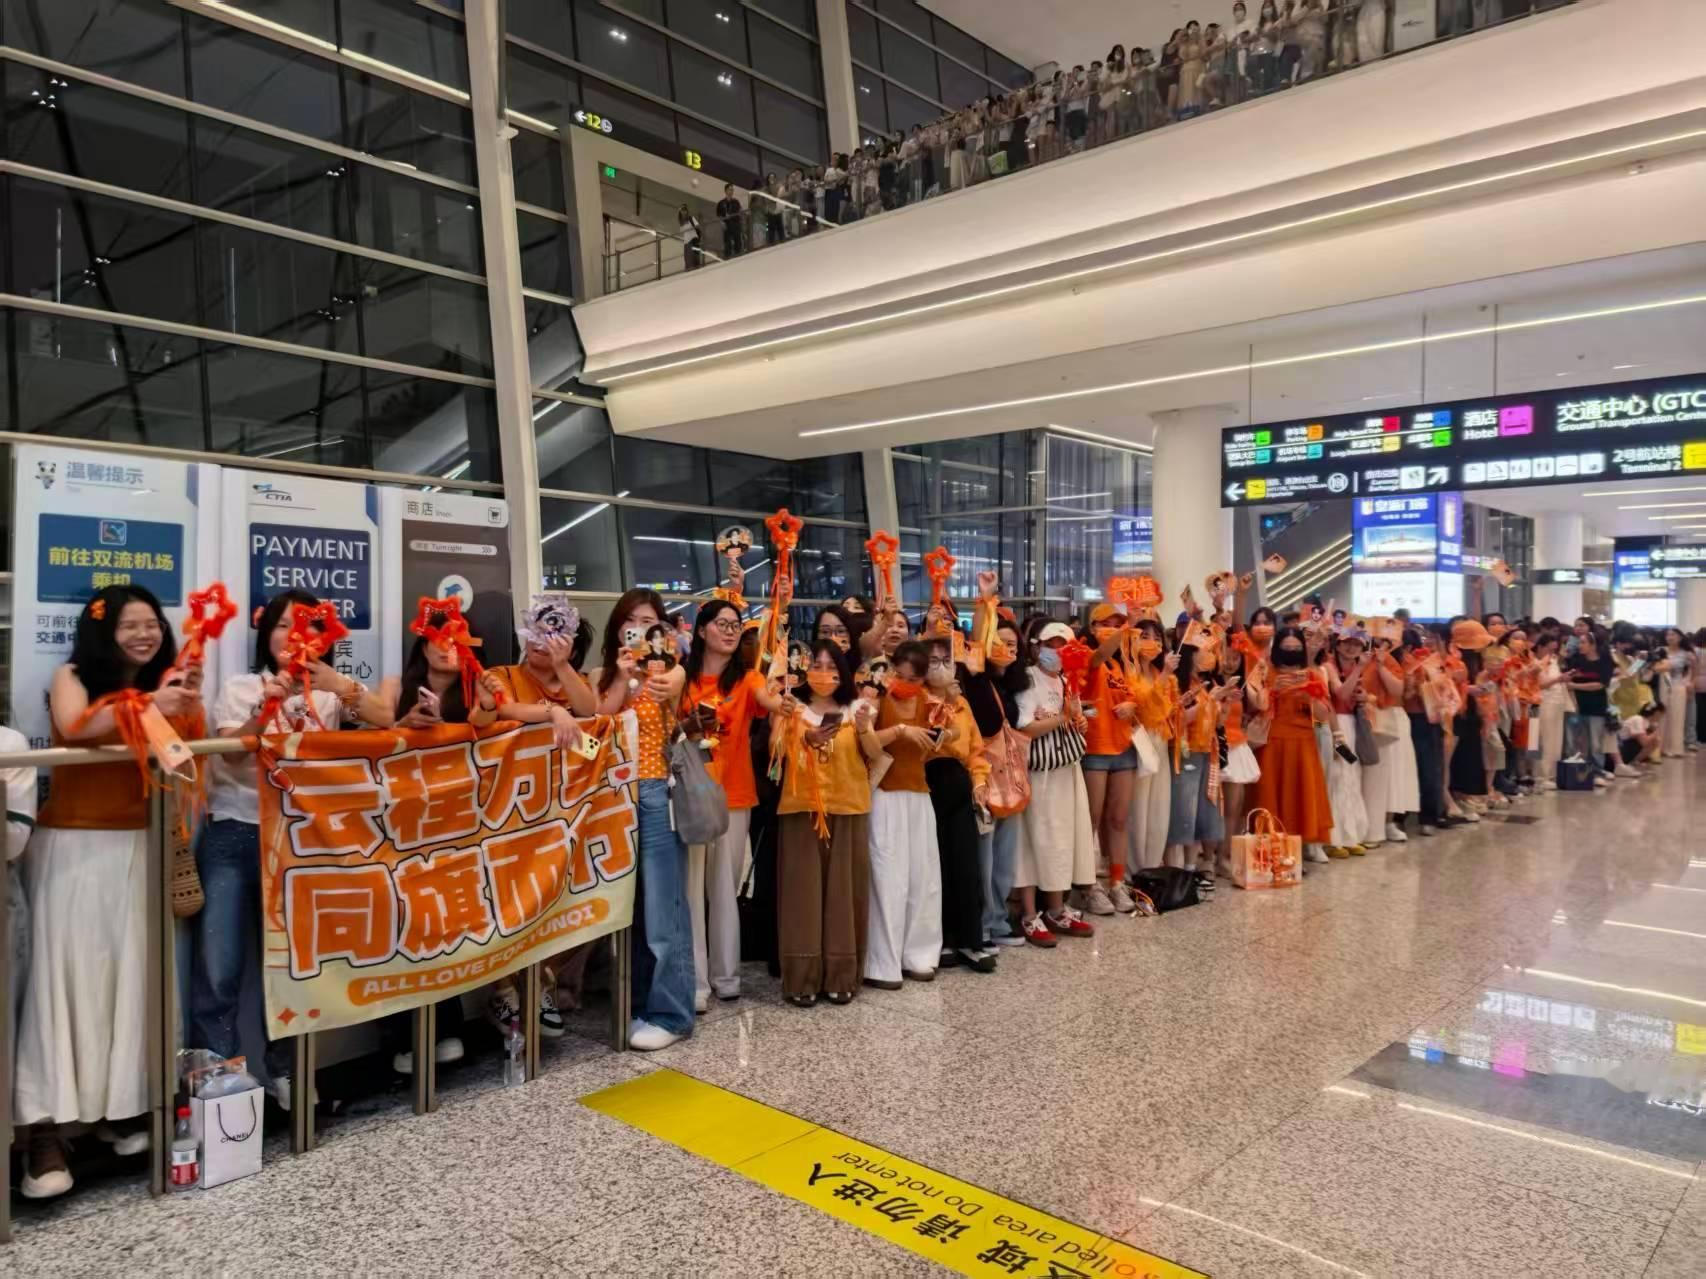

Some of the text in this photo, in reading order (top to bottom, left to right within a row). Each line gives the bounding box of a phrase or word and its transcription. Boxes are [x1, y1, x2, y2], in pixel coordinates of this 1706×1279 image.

[585, 112, 601, 129] 12
[685, 150, 702, 169] 13
[1463, 409, 1499, 427] 酒店
[1556, 393, 1649, 423] 交通中心
[1462, 428, 1499, 440] Hotel
[1612, 444, 1681, 463] 2号航站楼
[66, 461, 144, 485] 温馨提示
[1621, 460, 1682, 473] Terminal 2
[407, 500, 433, 516] 商店
[48, 546, 175, 571] 前往双流机场
[252, 535, 369, 561] PAYMENT
[263, 566, 358, 590] SERVICE
[284, 788, 638, 980] 同旗而行
[363, 976, 414, 998] ALL
[419, 961, 486, 986] LOVE
[832, 1151, 899, 1180] enter
[896, 1175, 945, 1198] not
[808, 1162, 971, 1244] 请勿进入
[944, 1194, 985, 1217] Do
[992, 1212, 1058, 1245] area
